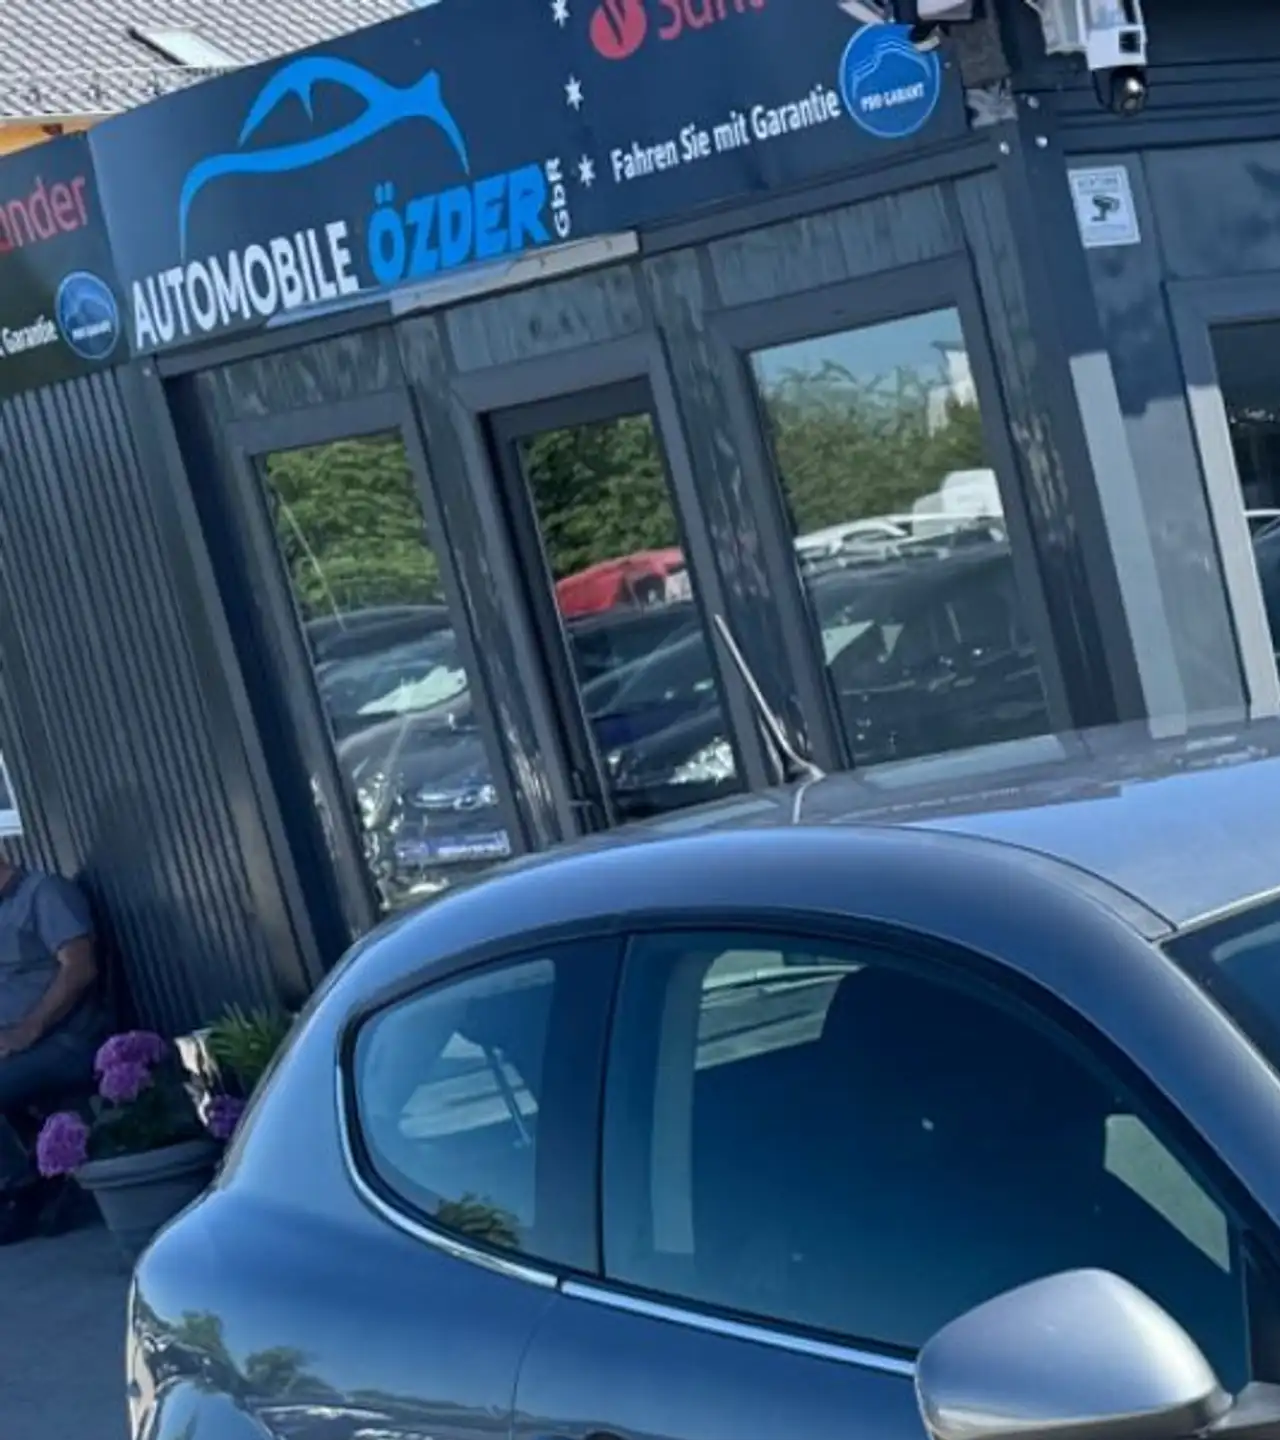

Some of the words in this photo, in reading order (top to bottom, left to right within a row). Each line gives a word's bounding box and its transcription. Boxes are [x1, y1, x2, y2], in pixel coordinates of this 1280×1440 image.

[610, 140, 679, 183] Fahren
[680, 122, 711, 161] Sie
[713, 110, 750, 154] mit
[751, 84, 842, 140] Garantie
[131, 220, 360, 350] AUTOMOBILE
[367, 164, 550, 287] ÖZDER
